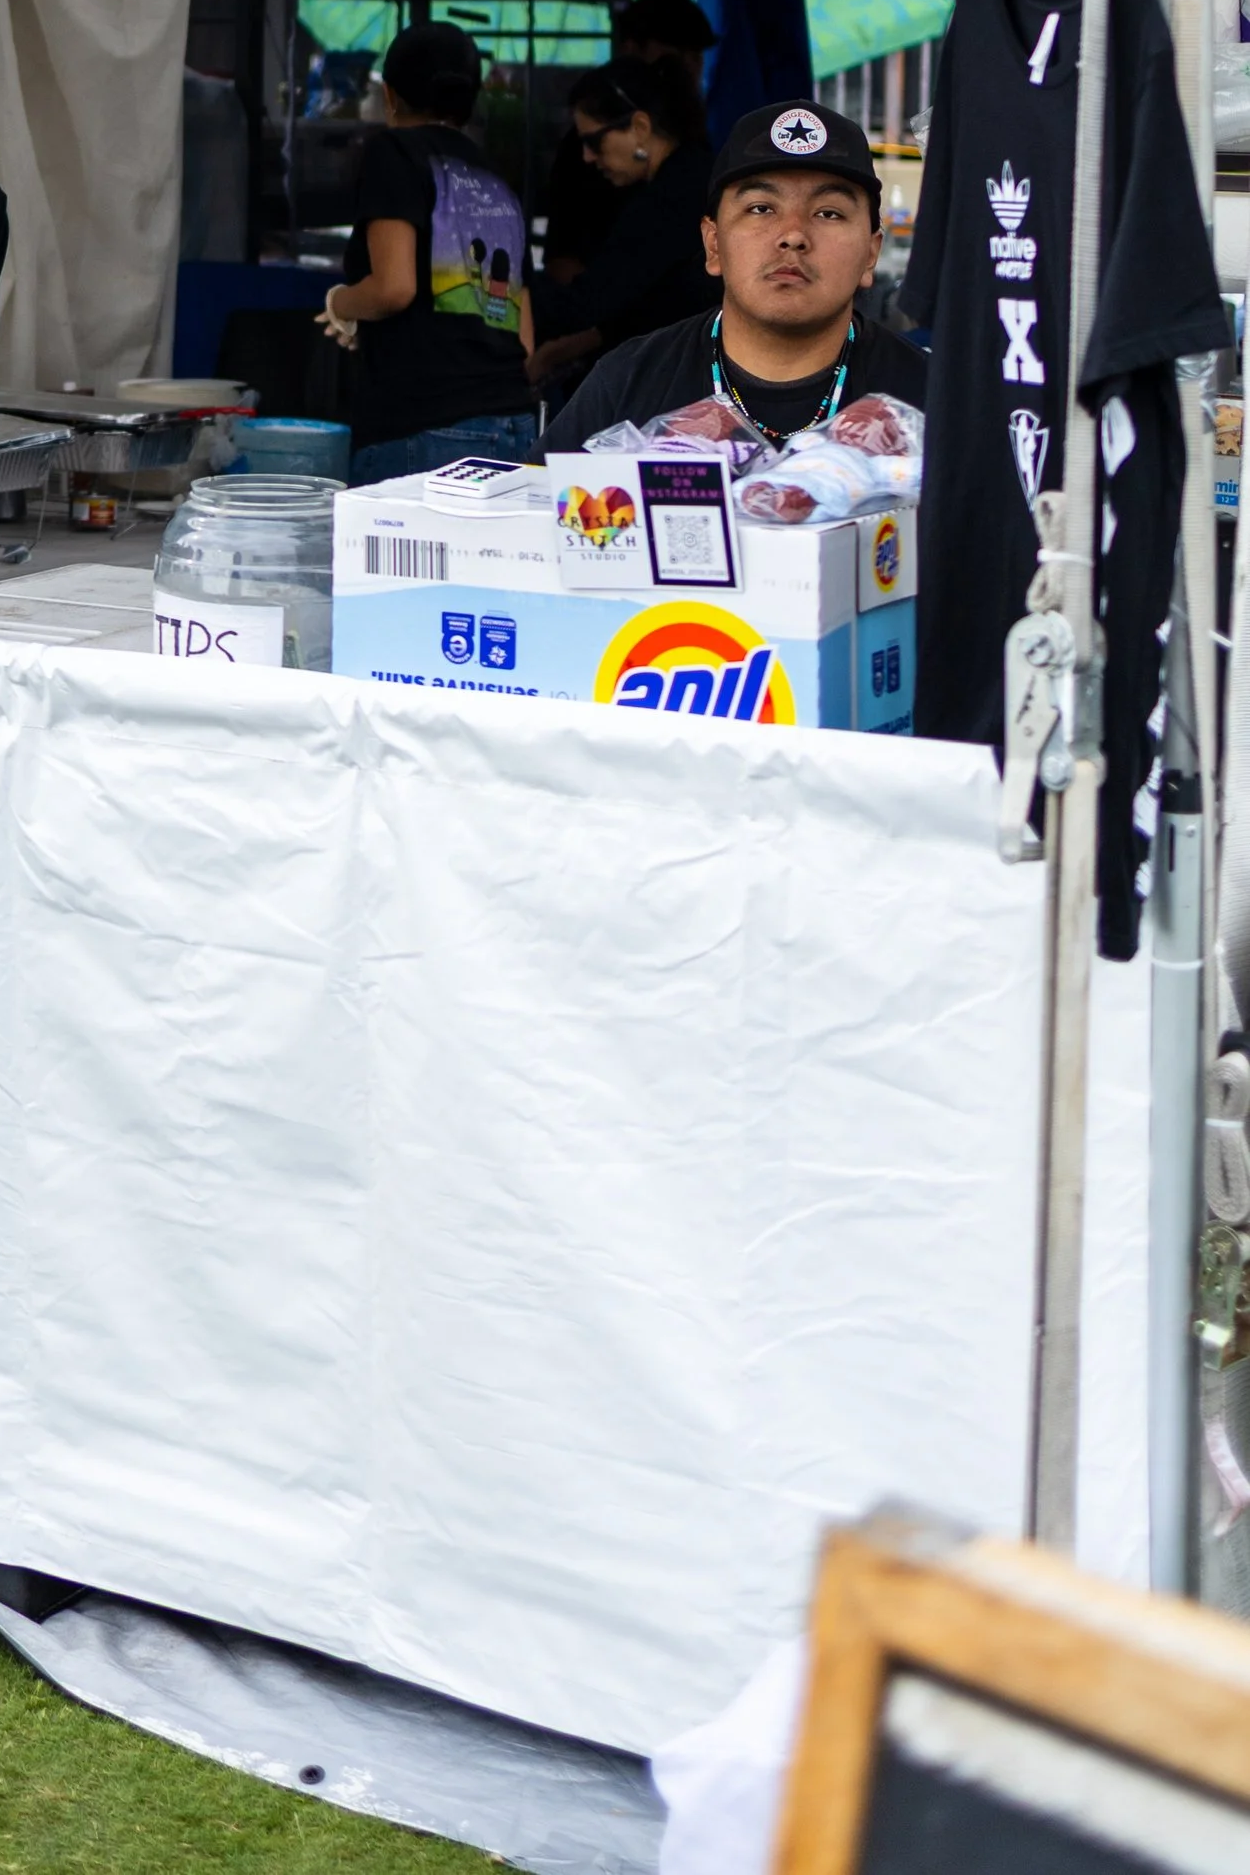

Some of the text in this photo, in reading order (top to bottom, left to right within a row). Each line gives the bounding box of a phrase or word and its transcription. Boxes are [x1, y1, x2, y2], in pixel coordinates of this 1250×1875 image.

[775, 111, 823, 131] INDIGENOUS
[780, 141, 819, 152] ALL STAR
[653, 466, 708, 476] FOLLOW
[672, 477, 693, 488] ON
[557, 516, 642, 528] CRYSTAL
[566, 534, 637, 547] STITCH
[580, 552, 627, 561] STUDIO
